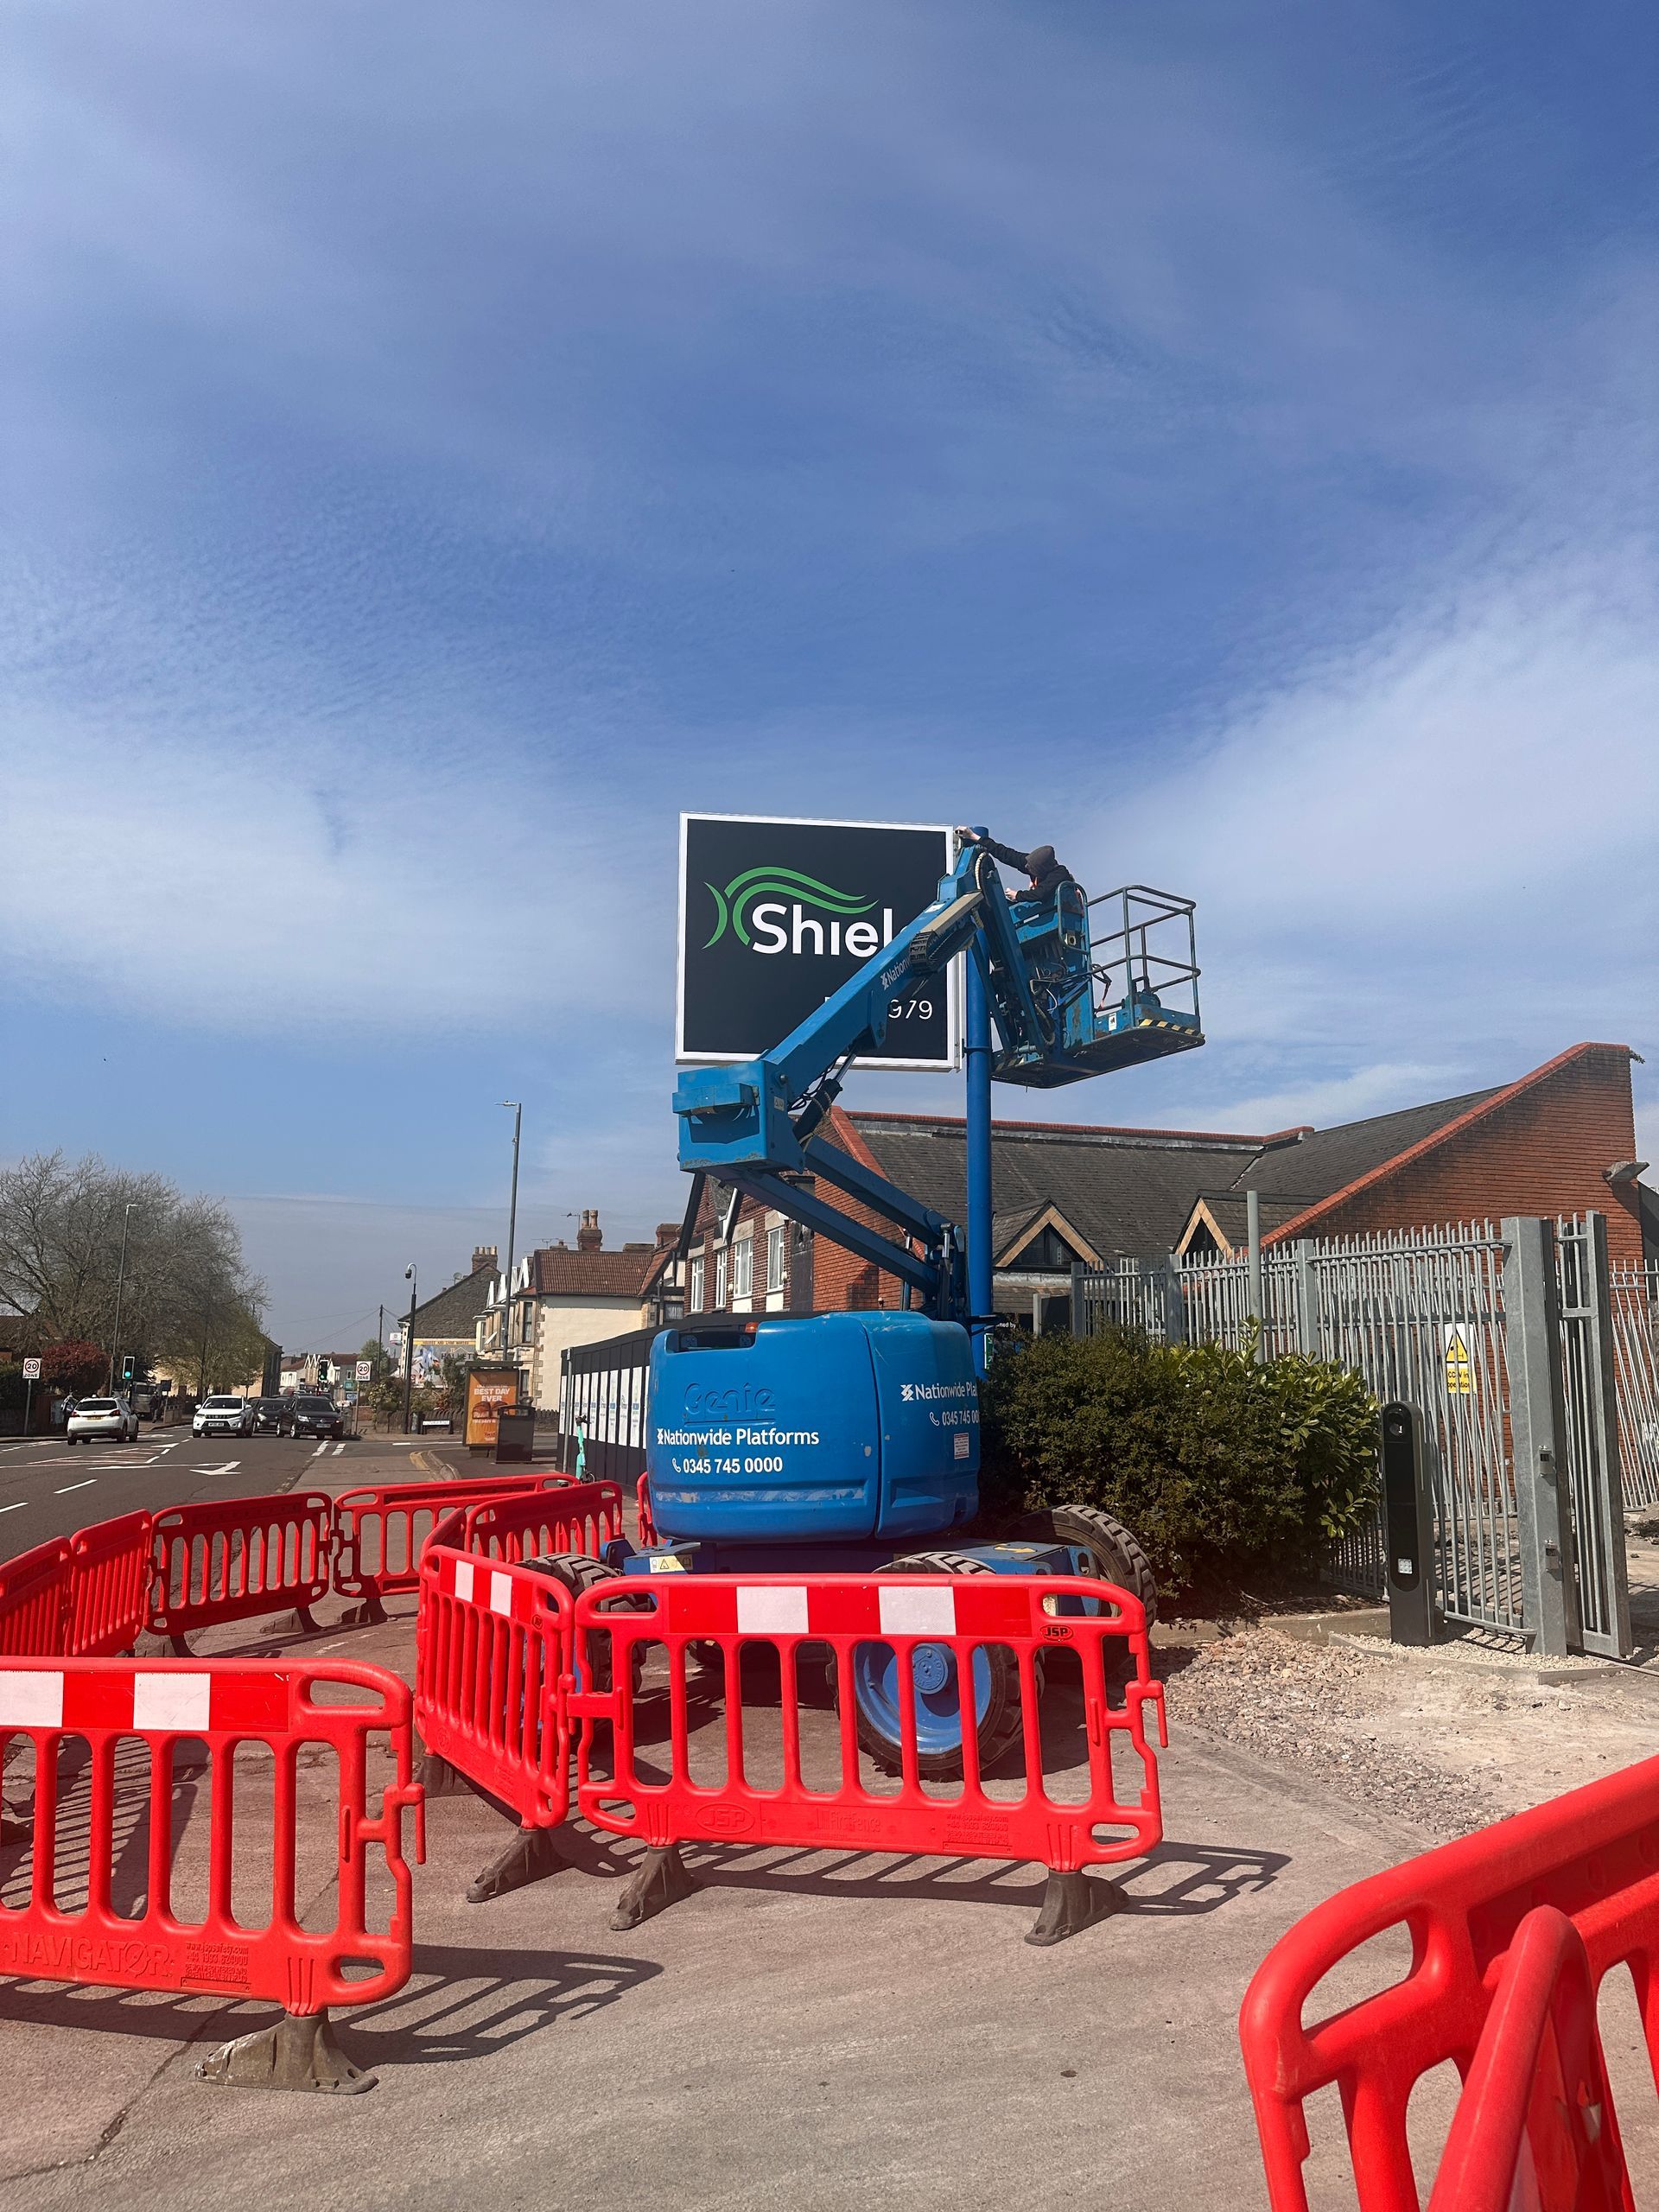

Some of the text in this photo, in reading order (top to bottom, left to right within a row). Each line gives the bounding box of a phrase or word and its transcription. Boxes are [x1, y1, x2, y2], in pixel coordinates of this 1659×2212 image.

[752, 903, 907, 957] Shiel
[683, 1382, 777, 1415] Genie
[914, 1382, 965, 1401] Nationwide
[942, 1411, 958, 1427] 0345
[959, 1410, 970, 1425] 745
[664, 1427, 820, 1446] Nationwide Platforms
[683, 1456, 784, 1474] 0345 745 0000
[1044, 1627, 1068, 1637] JSP
[703, 1808, 746, 1827] JSP
[12, 1931, 172, 1978] NAVIGATOR
